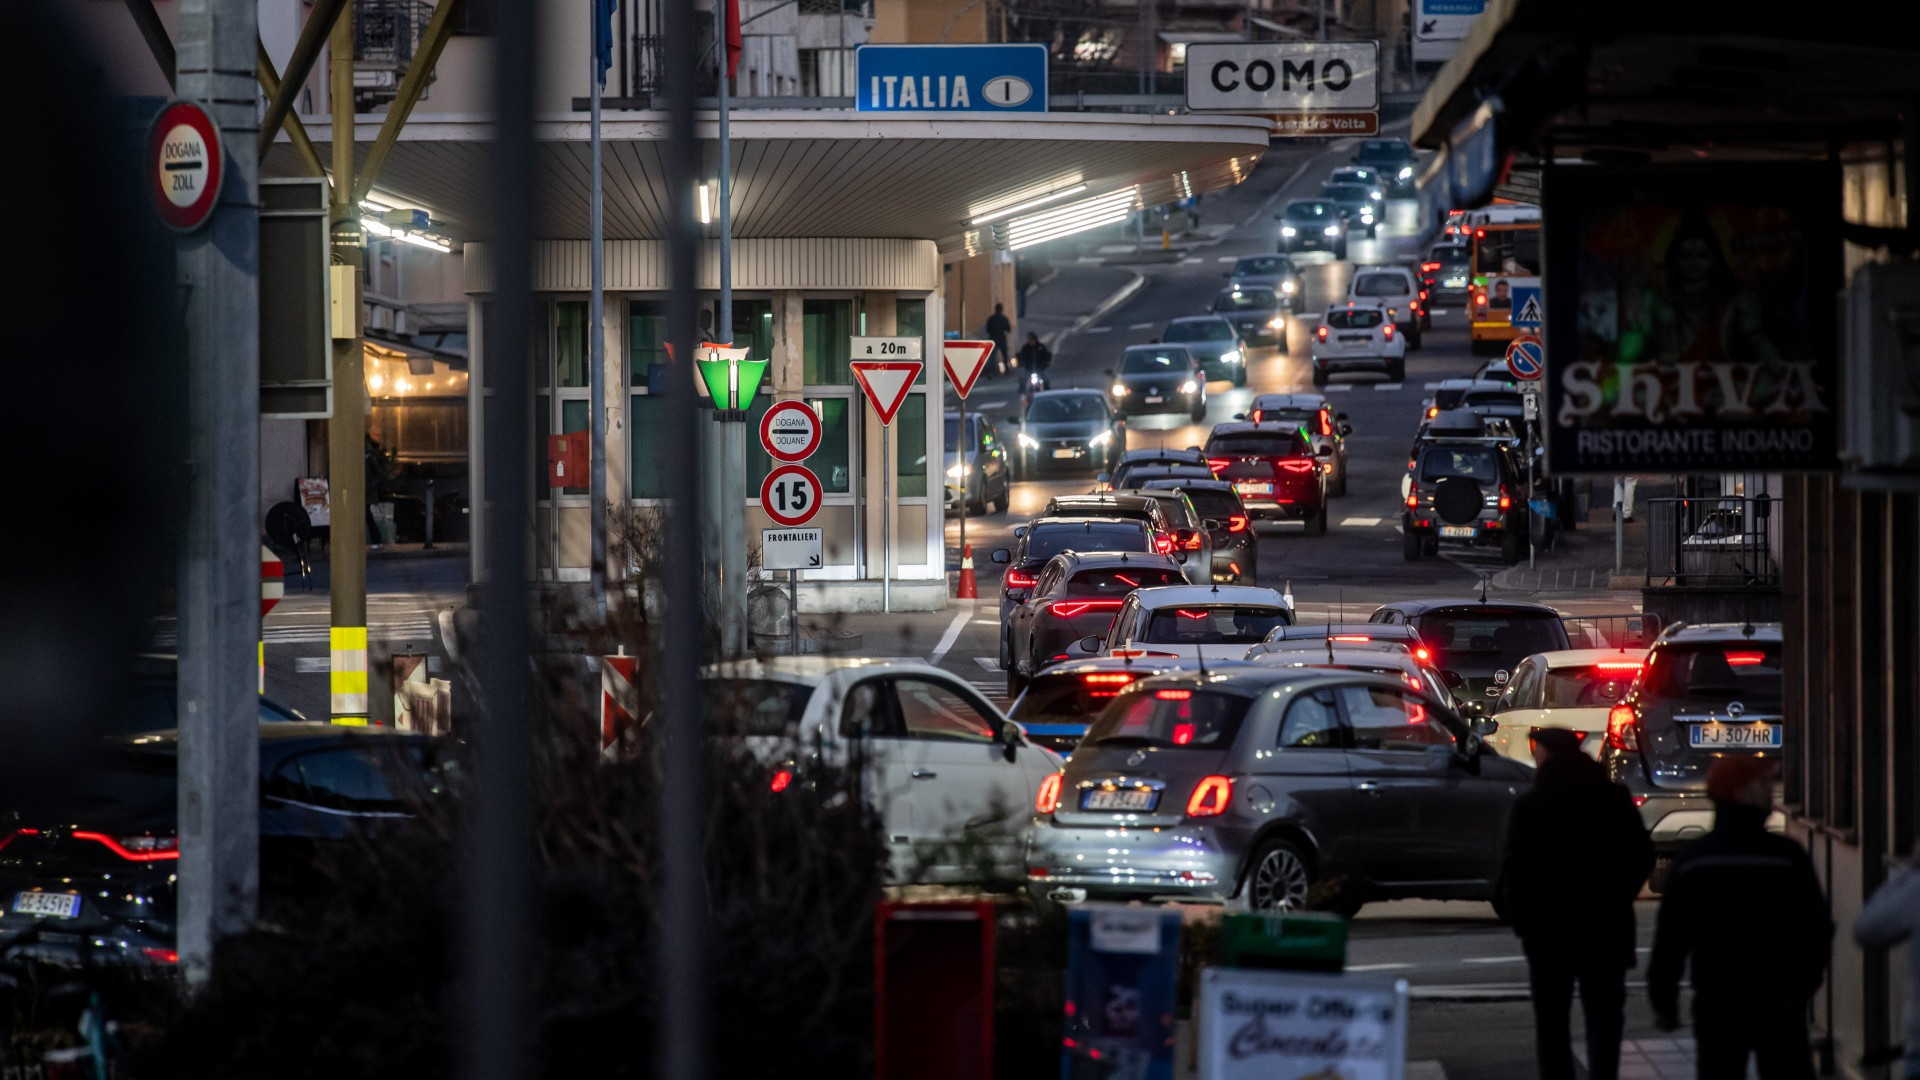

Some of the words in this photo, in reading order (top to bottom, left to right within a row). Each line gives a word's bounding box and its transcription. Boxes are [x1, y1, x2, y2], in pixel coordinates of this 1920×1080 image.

[1211, 59, 1352, 92] COMO
[871, 75, 970, 108] ITALIA
[1004, 81, 1010, 101] I
[1332, 118, 1367, 129] Volta
[165, 142, 201, 158] DOGANA
[172, 174, 194, 190] ZOLL
[866, 345, 873, 354] a
[881, 342, 906, 354] 20m
[776, 418, 806, 427] DOGANA
[776, 436, 806, 445] DOUANE
[1577, 427, 1716, 454] RISTORANTE
[1721, 427, 1814, 454] INDIANO
[775, 481, 807, 511] 15
[768, 533, 818, 542] FRONTALIERI
[1702, 728, 1720, 742] FJ
[1725, 728, 1771, 742] 307HR
[1222, 991, 1297, 1018] Super
